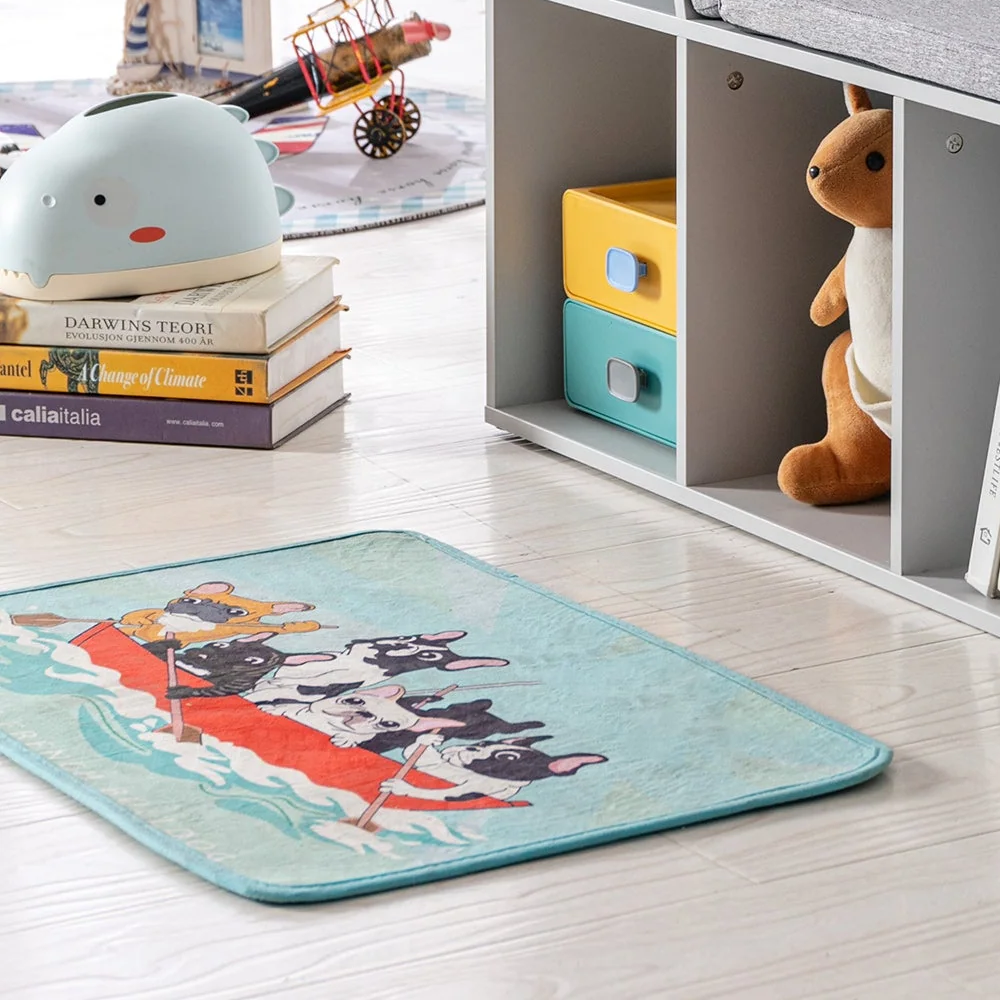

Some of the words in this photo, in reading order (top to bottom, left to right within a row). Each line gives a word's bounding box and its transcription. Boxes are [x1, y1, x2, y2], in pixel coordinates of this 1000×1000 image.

[64, 316, 151, 333] DARWINS
[156, 320, 214, 335] TEORI
[65, 331, 124, 343] EVOLUSJON
[125, 334, 175, 344] GJENNOM
[178, 337, 198, 345] 400
[200, 335, 214, 346] ÅR
[0, 360, 32, 377] antel
[77, 363, 87, 382] A
[90, 363, 138, 390] Change
[139, 366, 155, 392] of
[155, 366, 207, 388] Climate
[11, 405, 101, 426] caliaitalia
